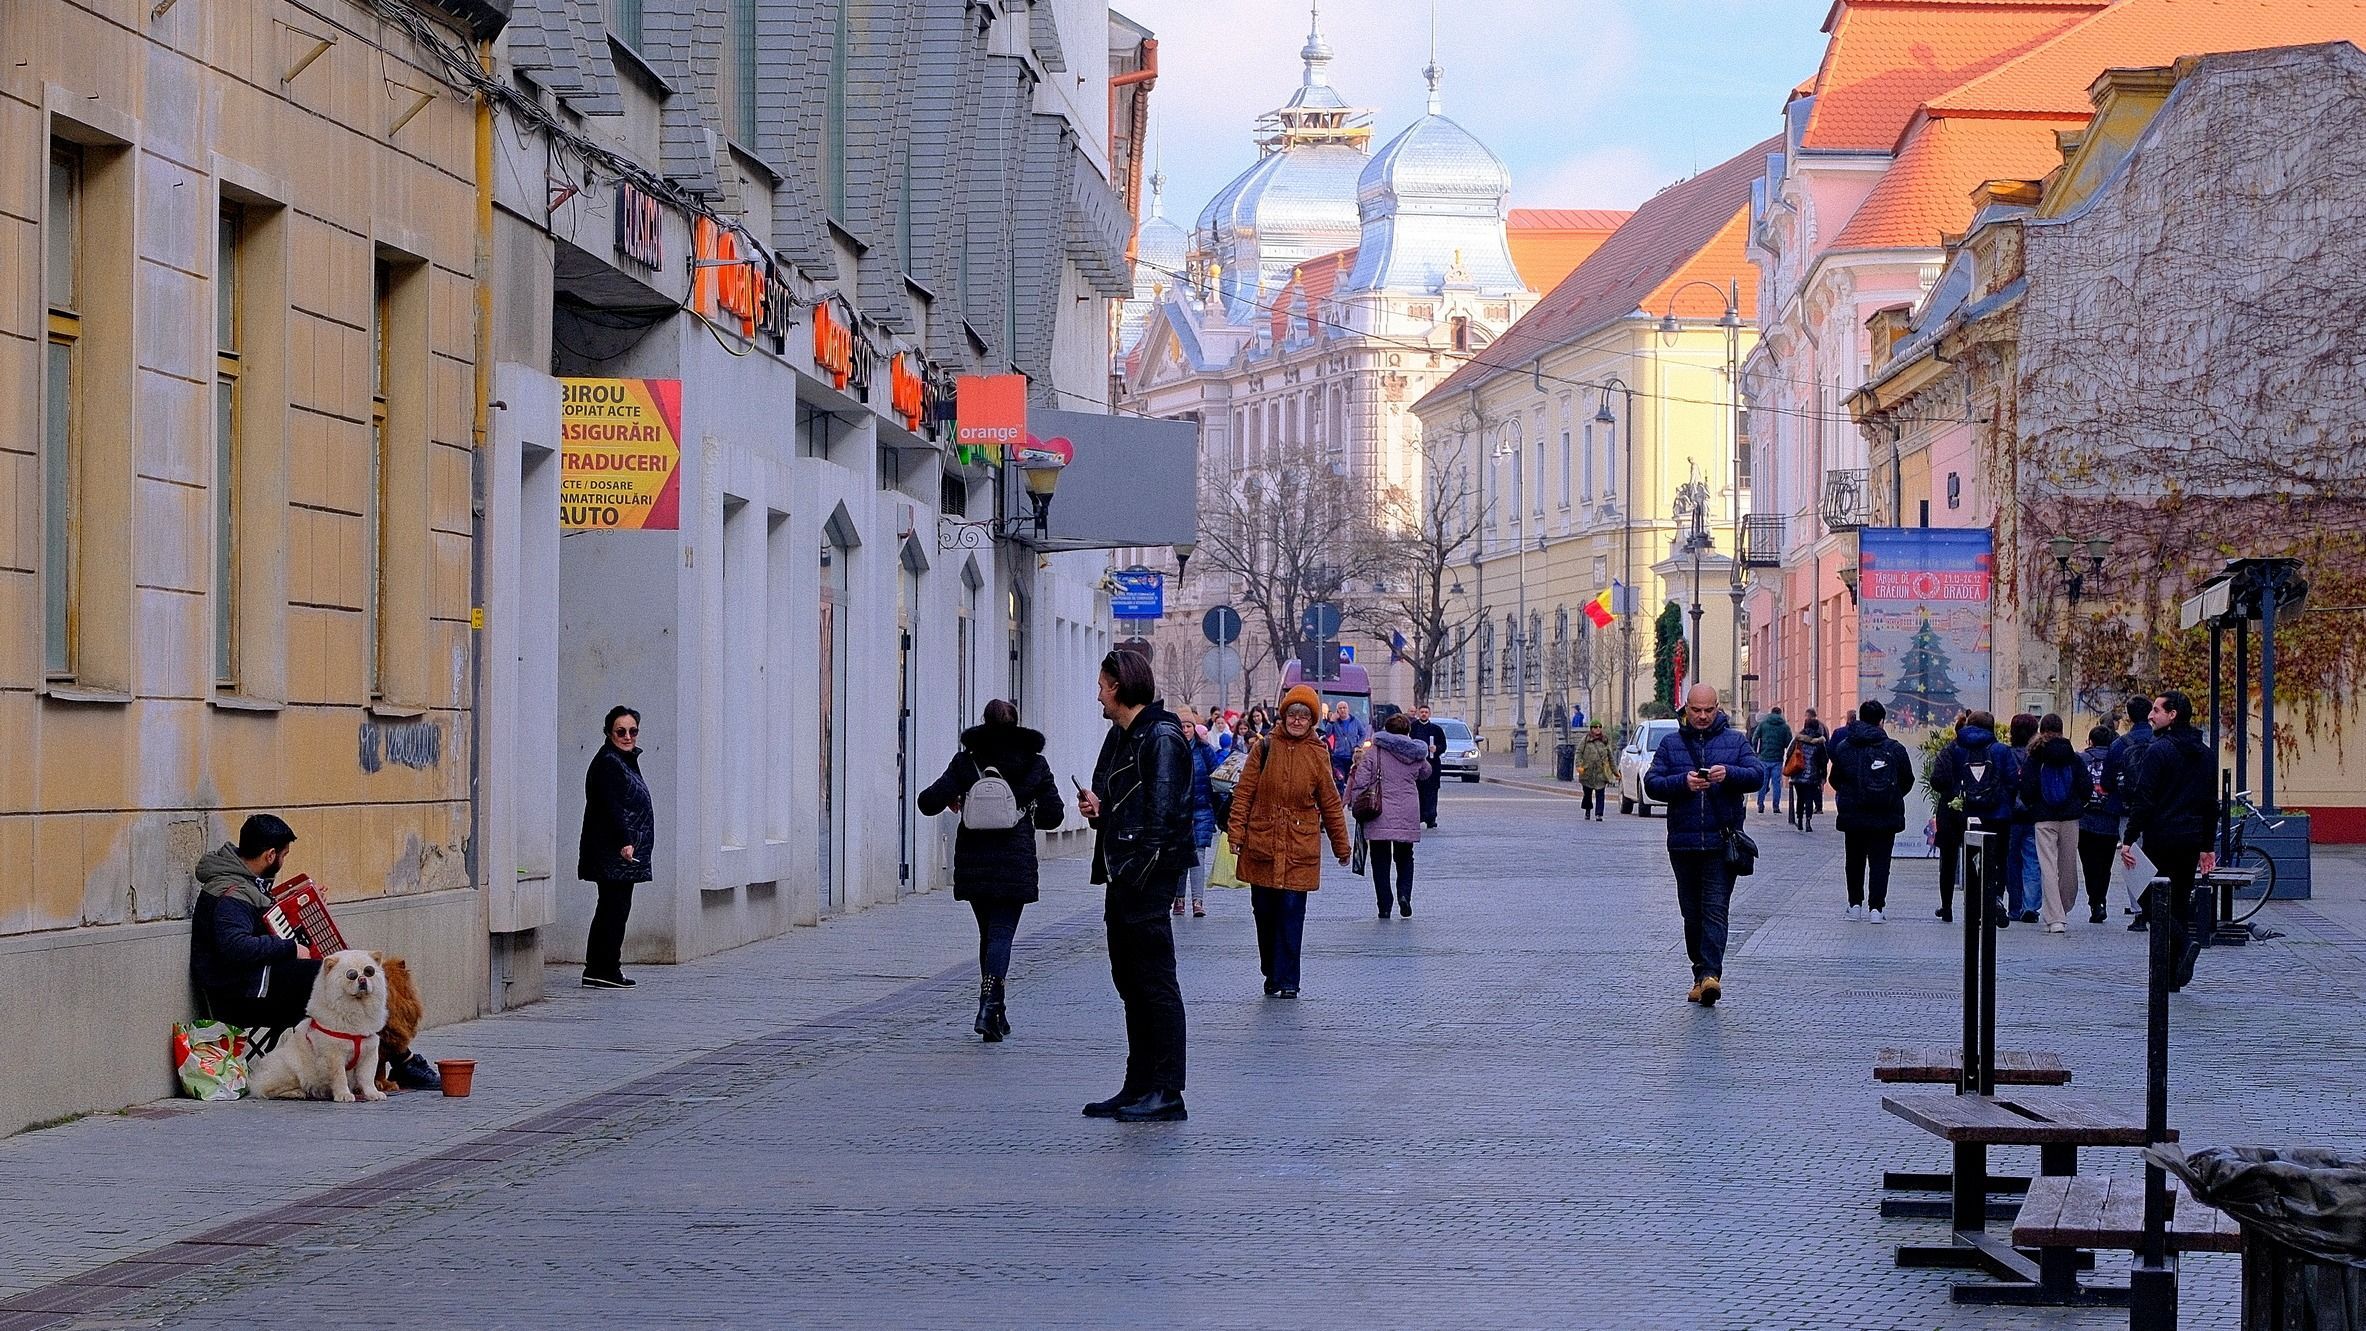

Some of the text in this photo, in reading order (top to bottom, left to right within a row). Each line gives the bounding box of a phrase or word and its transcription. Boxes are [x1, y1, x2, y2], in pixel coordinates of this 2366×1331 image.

[562, 385, 625, 404] BIROU
[562, 405, 641, 417] OPIAT ACTE
[561, 422, 661, 442] ASIGURĂRI
[960, 427, 1018, 442] orange
[561, 452, 668, 472] TRADUCERI
[561, 480, 582, 489] CTE
[590, 480, 634, 490] DOSARE
[560, 506, 619, 526] AUTO
[1943, 586, 1981, 600] ORADEA
